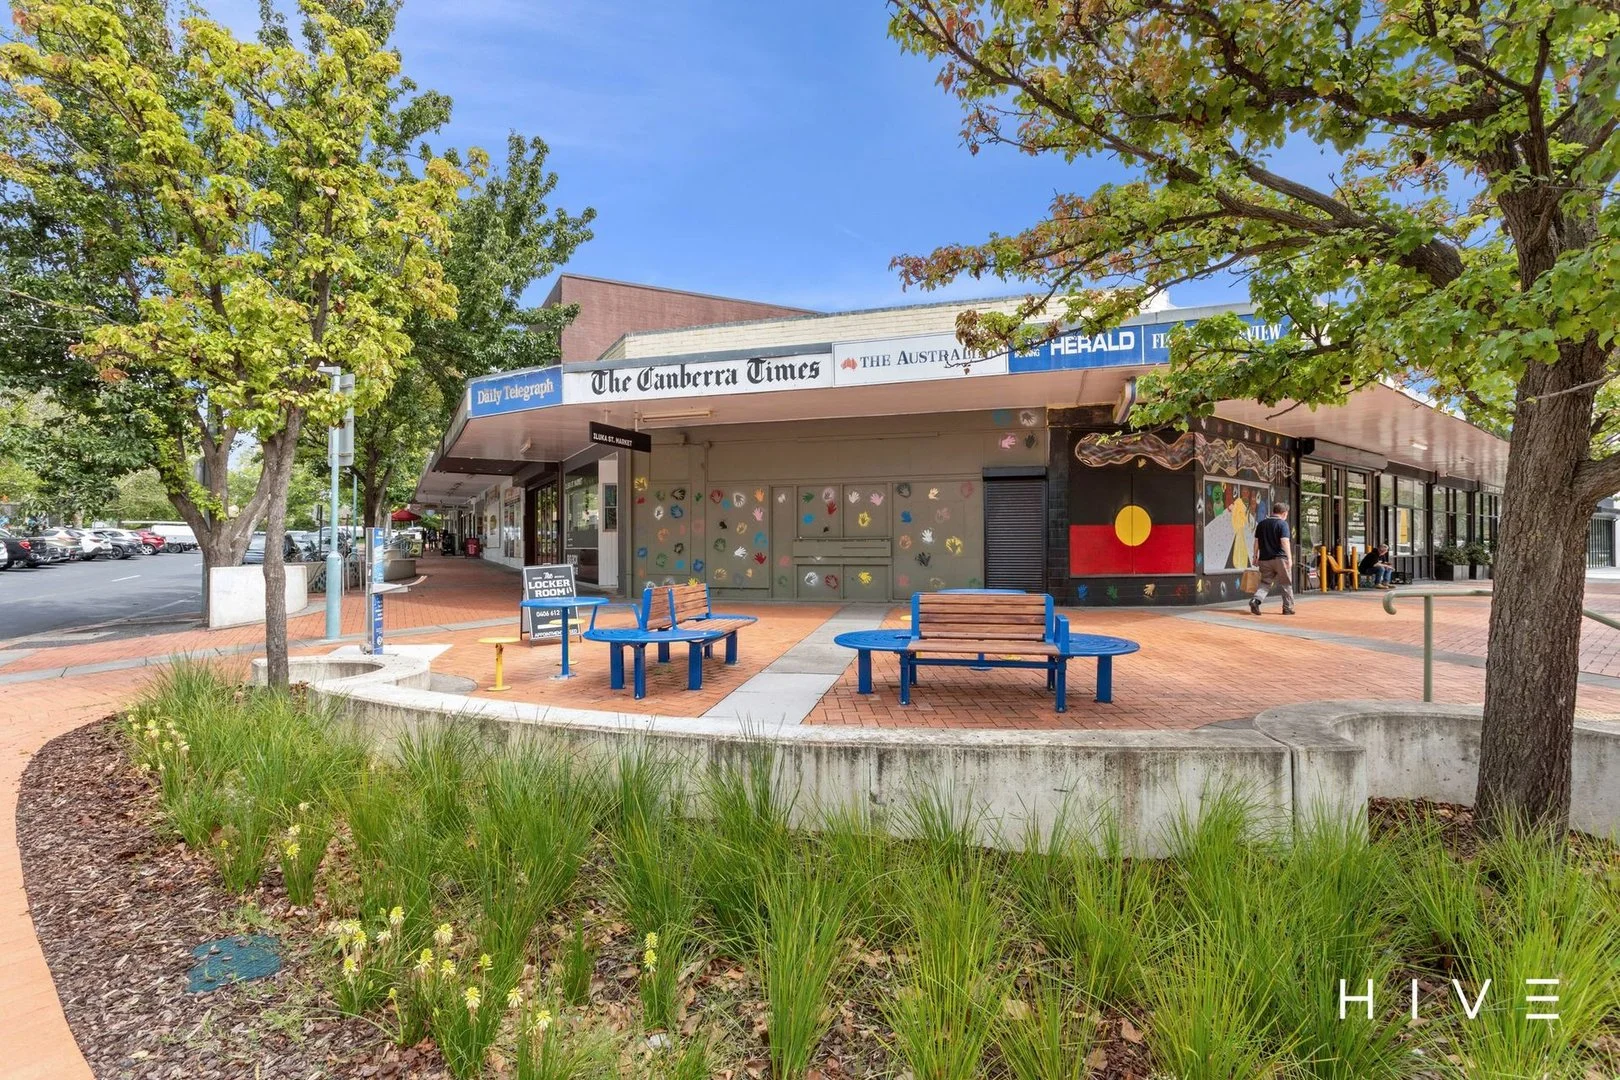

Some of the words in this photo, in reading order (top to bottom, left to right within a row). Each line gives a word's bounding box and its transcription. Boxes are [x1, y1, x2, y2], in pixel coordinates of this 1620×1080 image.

[1050, 330, 1135, 356] HERALD
[860, 354, 891, 368] THE
[591, 368, 632, 395] The
[637, 363, 738, 392] Canberra
[747, 357, 821, 385] Times
[477, 387, 502, 406] Daily
[503, 378, 554, 401] Telegraph
[593, 432, 607, 442] ILUKA
[616, 437, 632, 447] MARKET
[528, 579, 571, 590] LOCKER
[535, 588, 566, 598] ROOM
